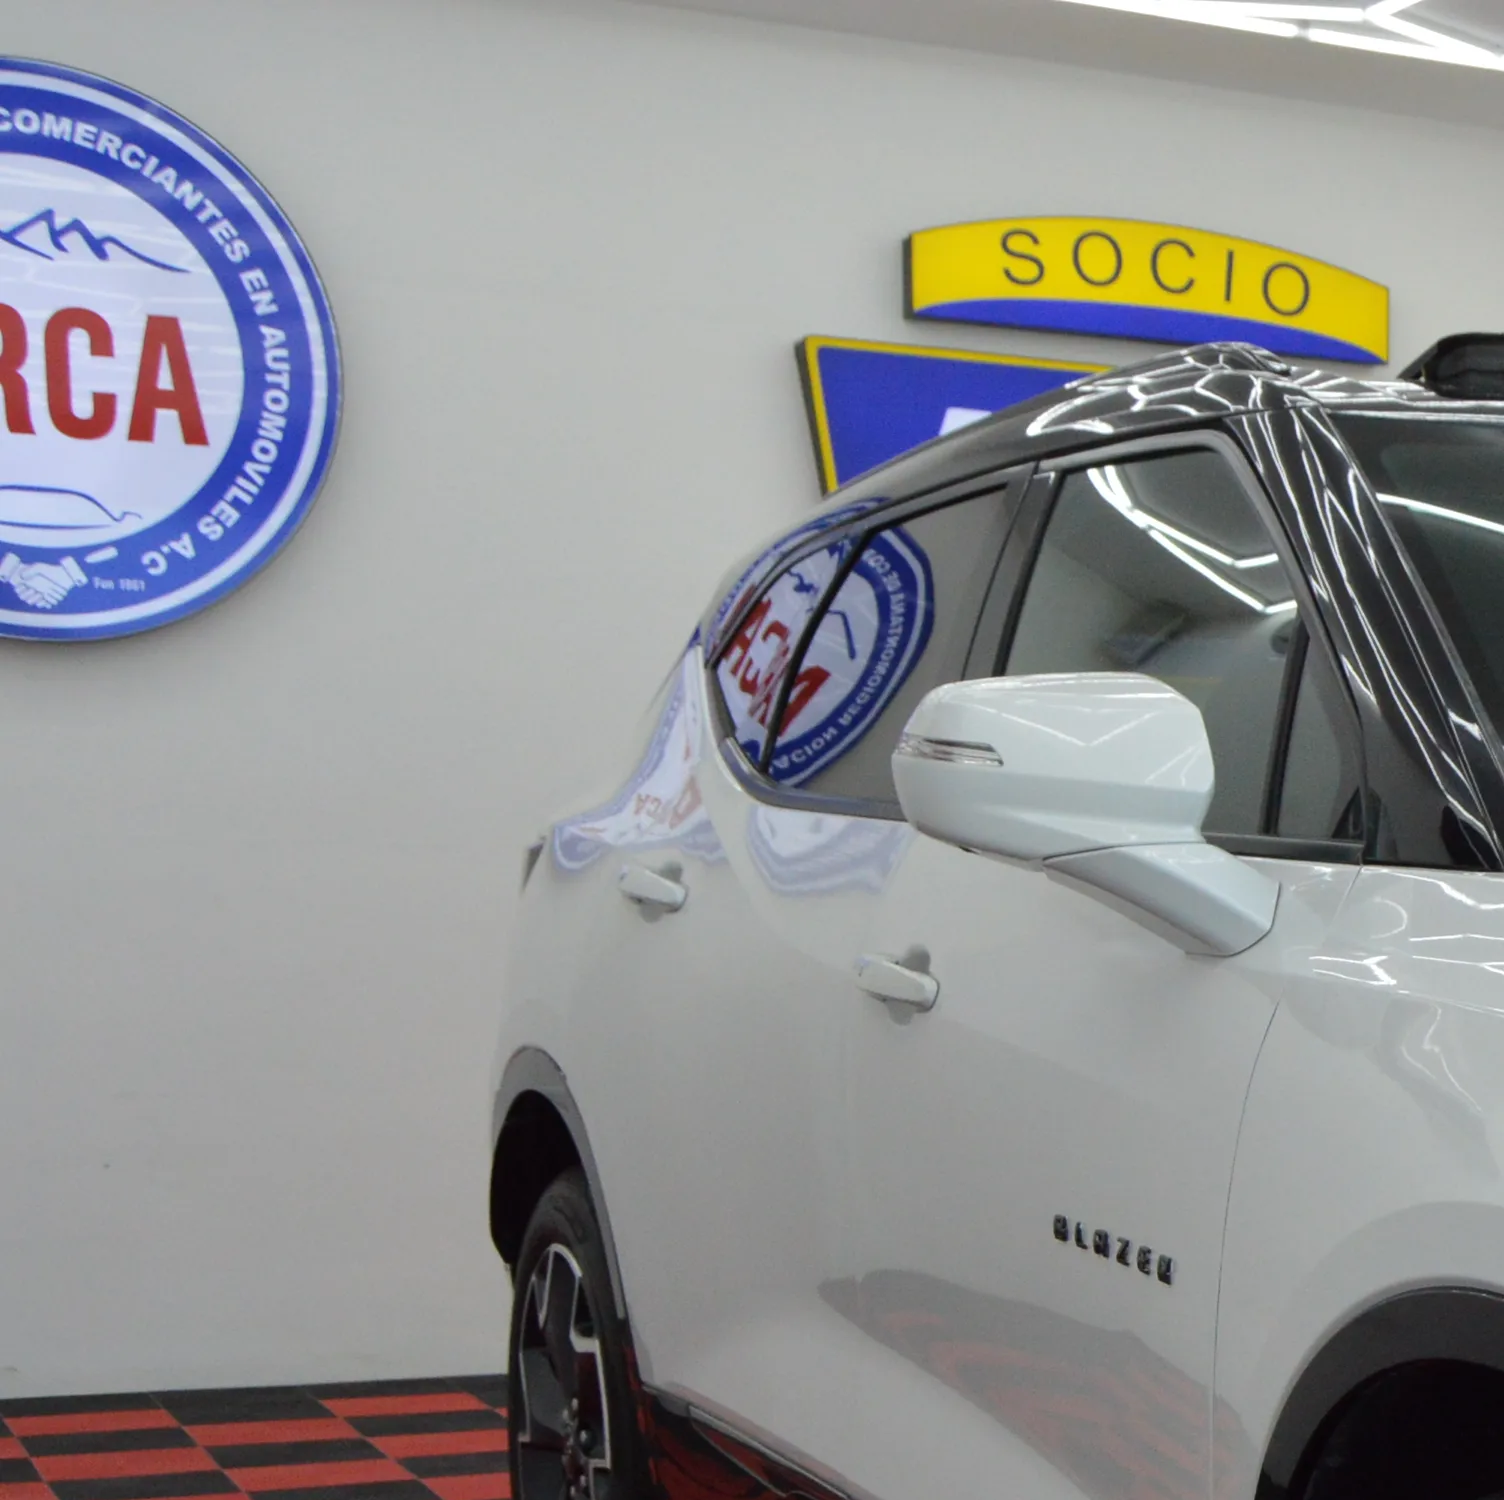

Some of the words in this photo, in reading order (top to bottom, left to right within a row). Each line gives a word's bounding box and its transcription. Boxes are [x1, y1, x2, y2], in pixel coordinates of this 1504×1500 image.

[239, 267, 279, 316] EN
[1000, 229, 1312, 316] SOCIO
[196, 324, 290, 541] AUTOMOVILES
[1053, 1214, 1175, 1285] BLAZER
